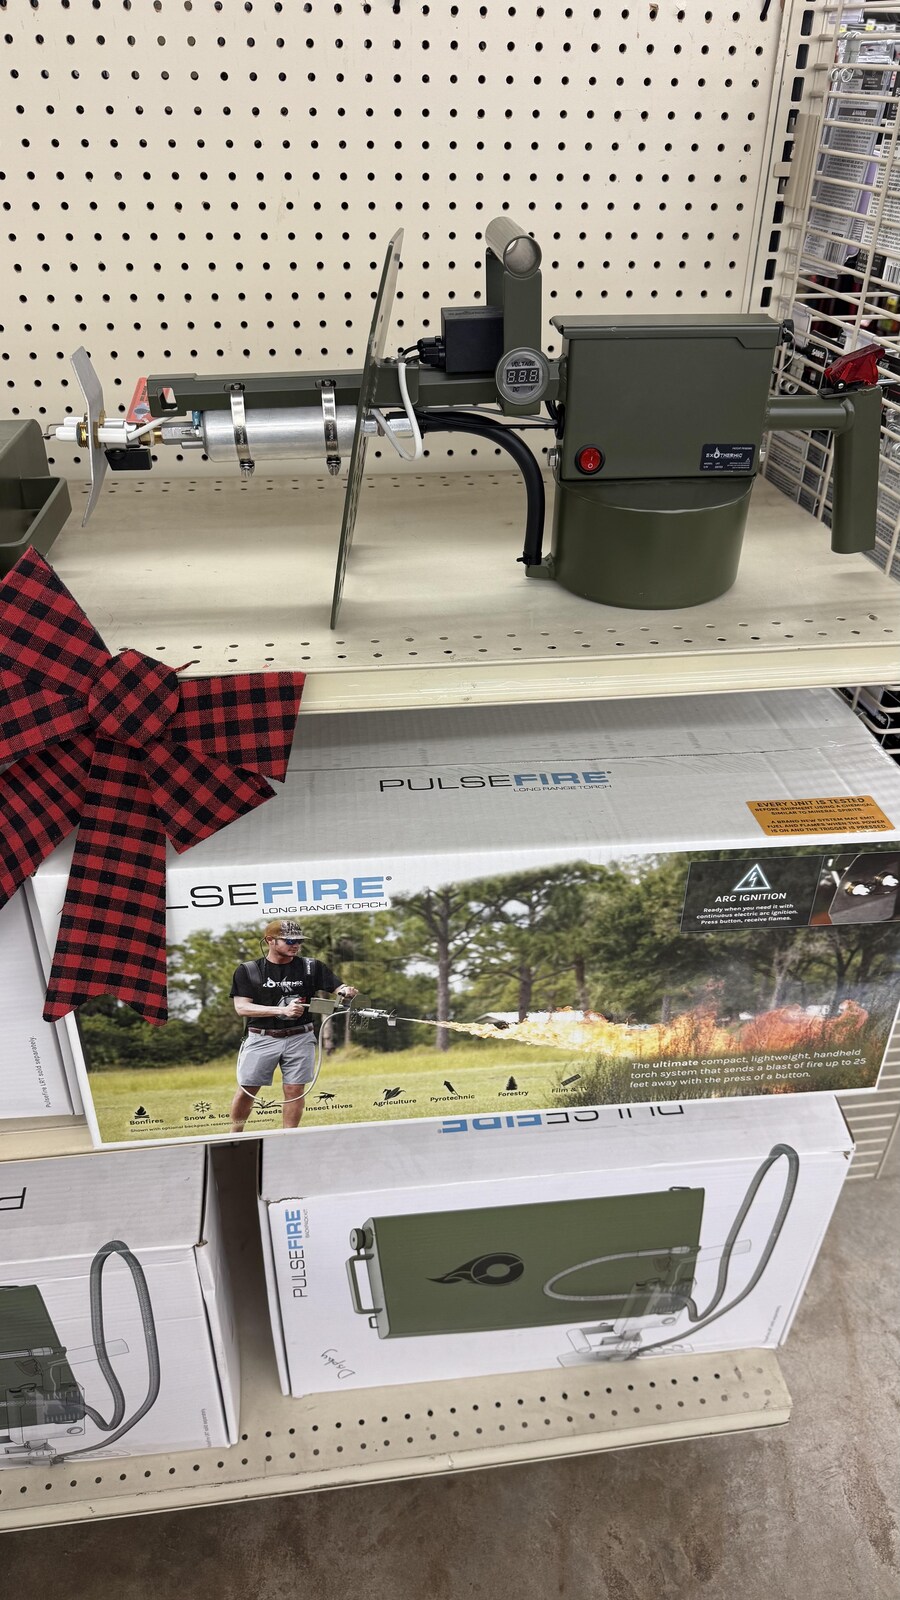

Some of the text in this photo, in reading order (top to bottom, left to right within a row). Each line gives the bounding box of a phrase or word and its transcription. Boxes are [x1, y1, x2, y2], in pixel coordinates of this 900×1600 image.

[740, 892, 787, 902] IGNITION
[262, 901, 388, 914] LONG RANGE TORCH
[652, 1059, 698, 1068] ultimate
[700, 1057, 749, 1066] compact,
[751, 1052, 811, 1063] lightweight,
[813, 1049, 862, 1058] handheld
[660, 1070, 697, 1078] system
[723, 1064, 754, 1073] sends
[766, 1062, 792, 1071] blast
[806, 1060, 824, 1068] fire
[630, 1080, 649, 1089] feet
[723, 1075, 752, 1084] press
[775, 1070, 811, 1079] button.
[372, 1098, 417, 1106] Agriculture
[430, 1094, 475, 1102] Pyrotechnic
